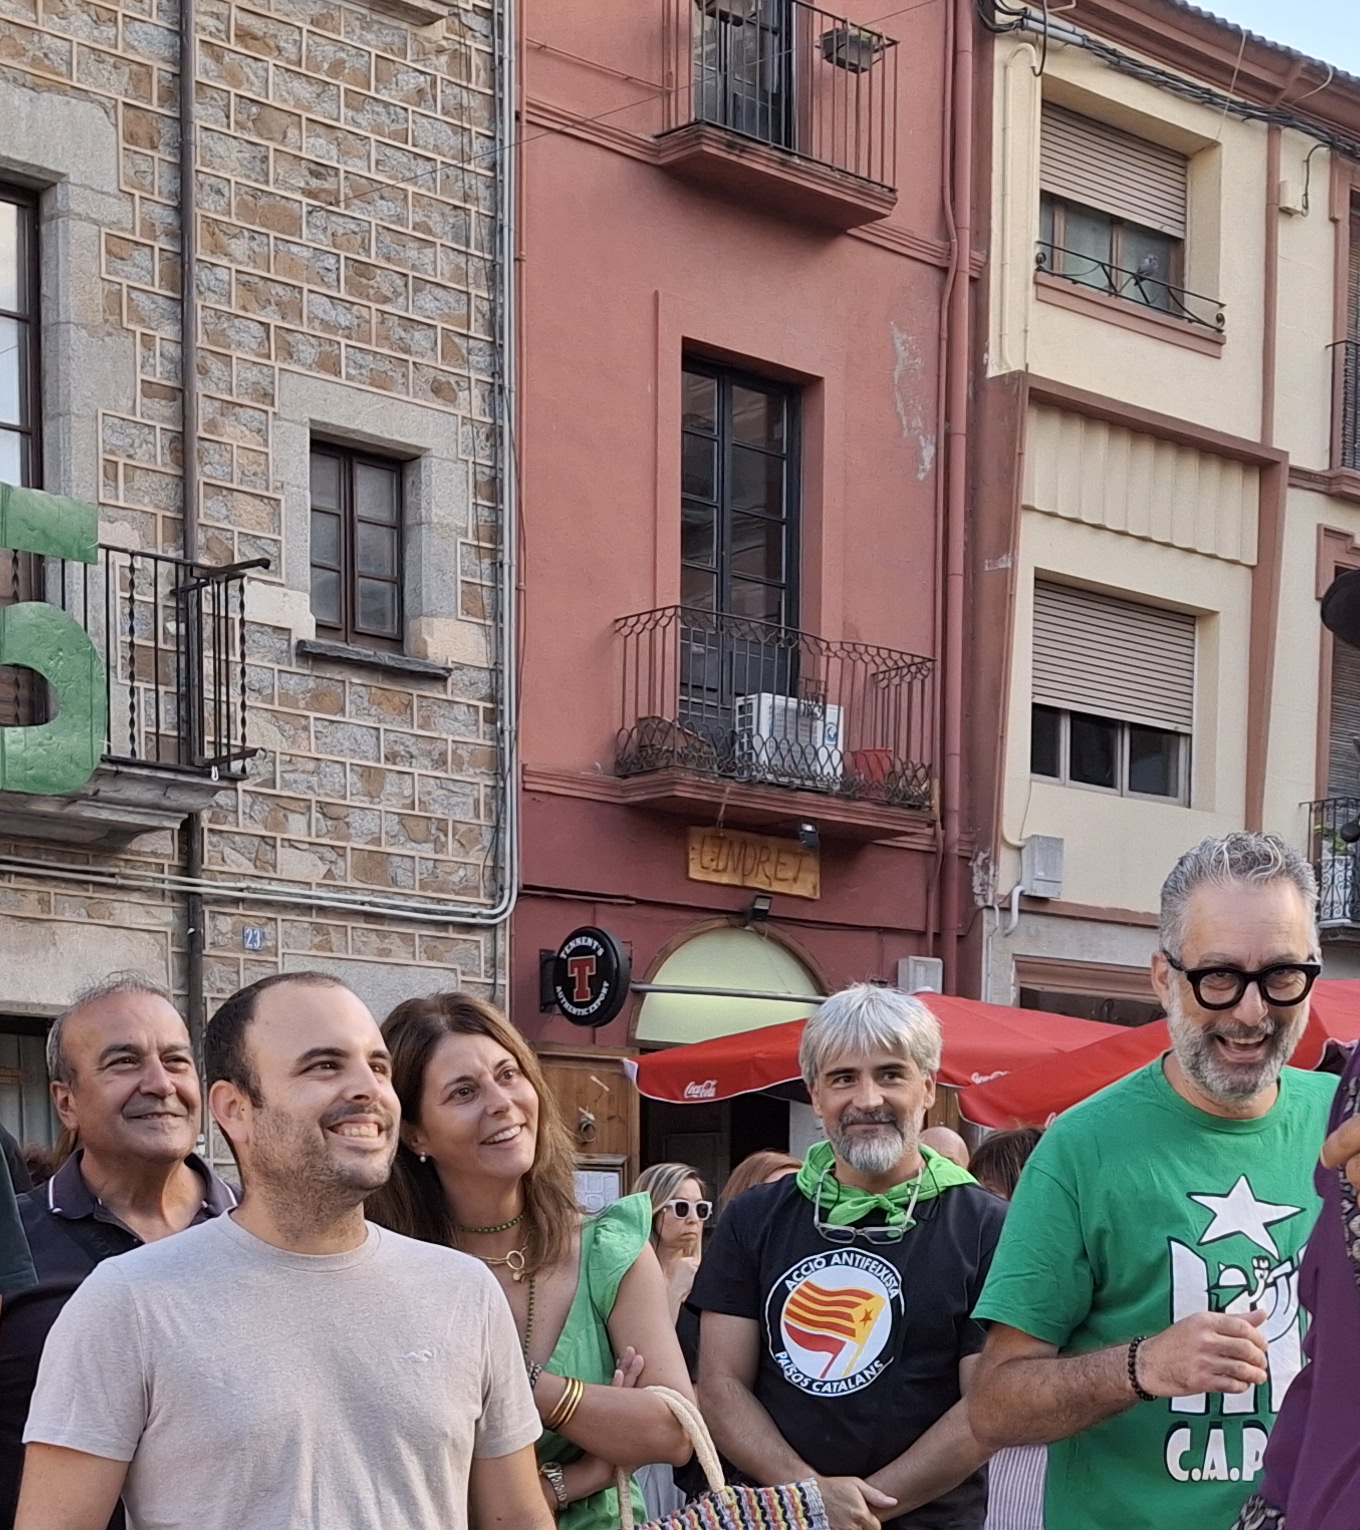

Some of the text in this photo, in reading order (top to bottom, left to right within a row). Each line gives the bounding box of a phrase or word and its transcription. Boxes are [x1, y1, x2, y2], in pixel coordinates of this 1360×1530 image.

[244, 927, 262, 949] 23
[559, 936, 605, 960] TENNENT'S
[567, 954, 597, 1003] T
[555, 980, 610, 1017] AUTHENTIC EXPORT
[784, 1251, 901, 1300] ACCIÓ ANTIFEIXISTA
[811, 1359, 884, 1394] CATALANS
